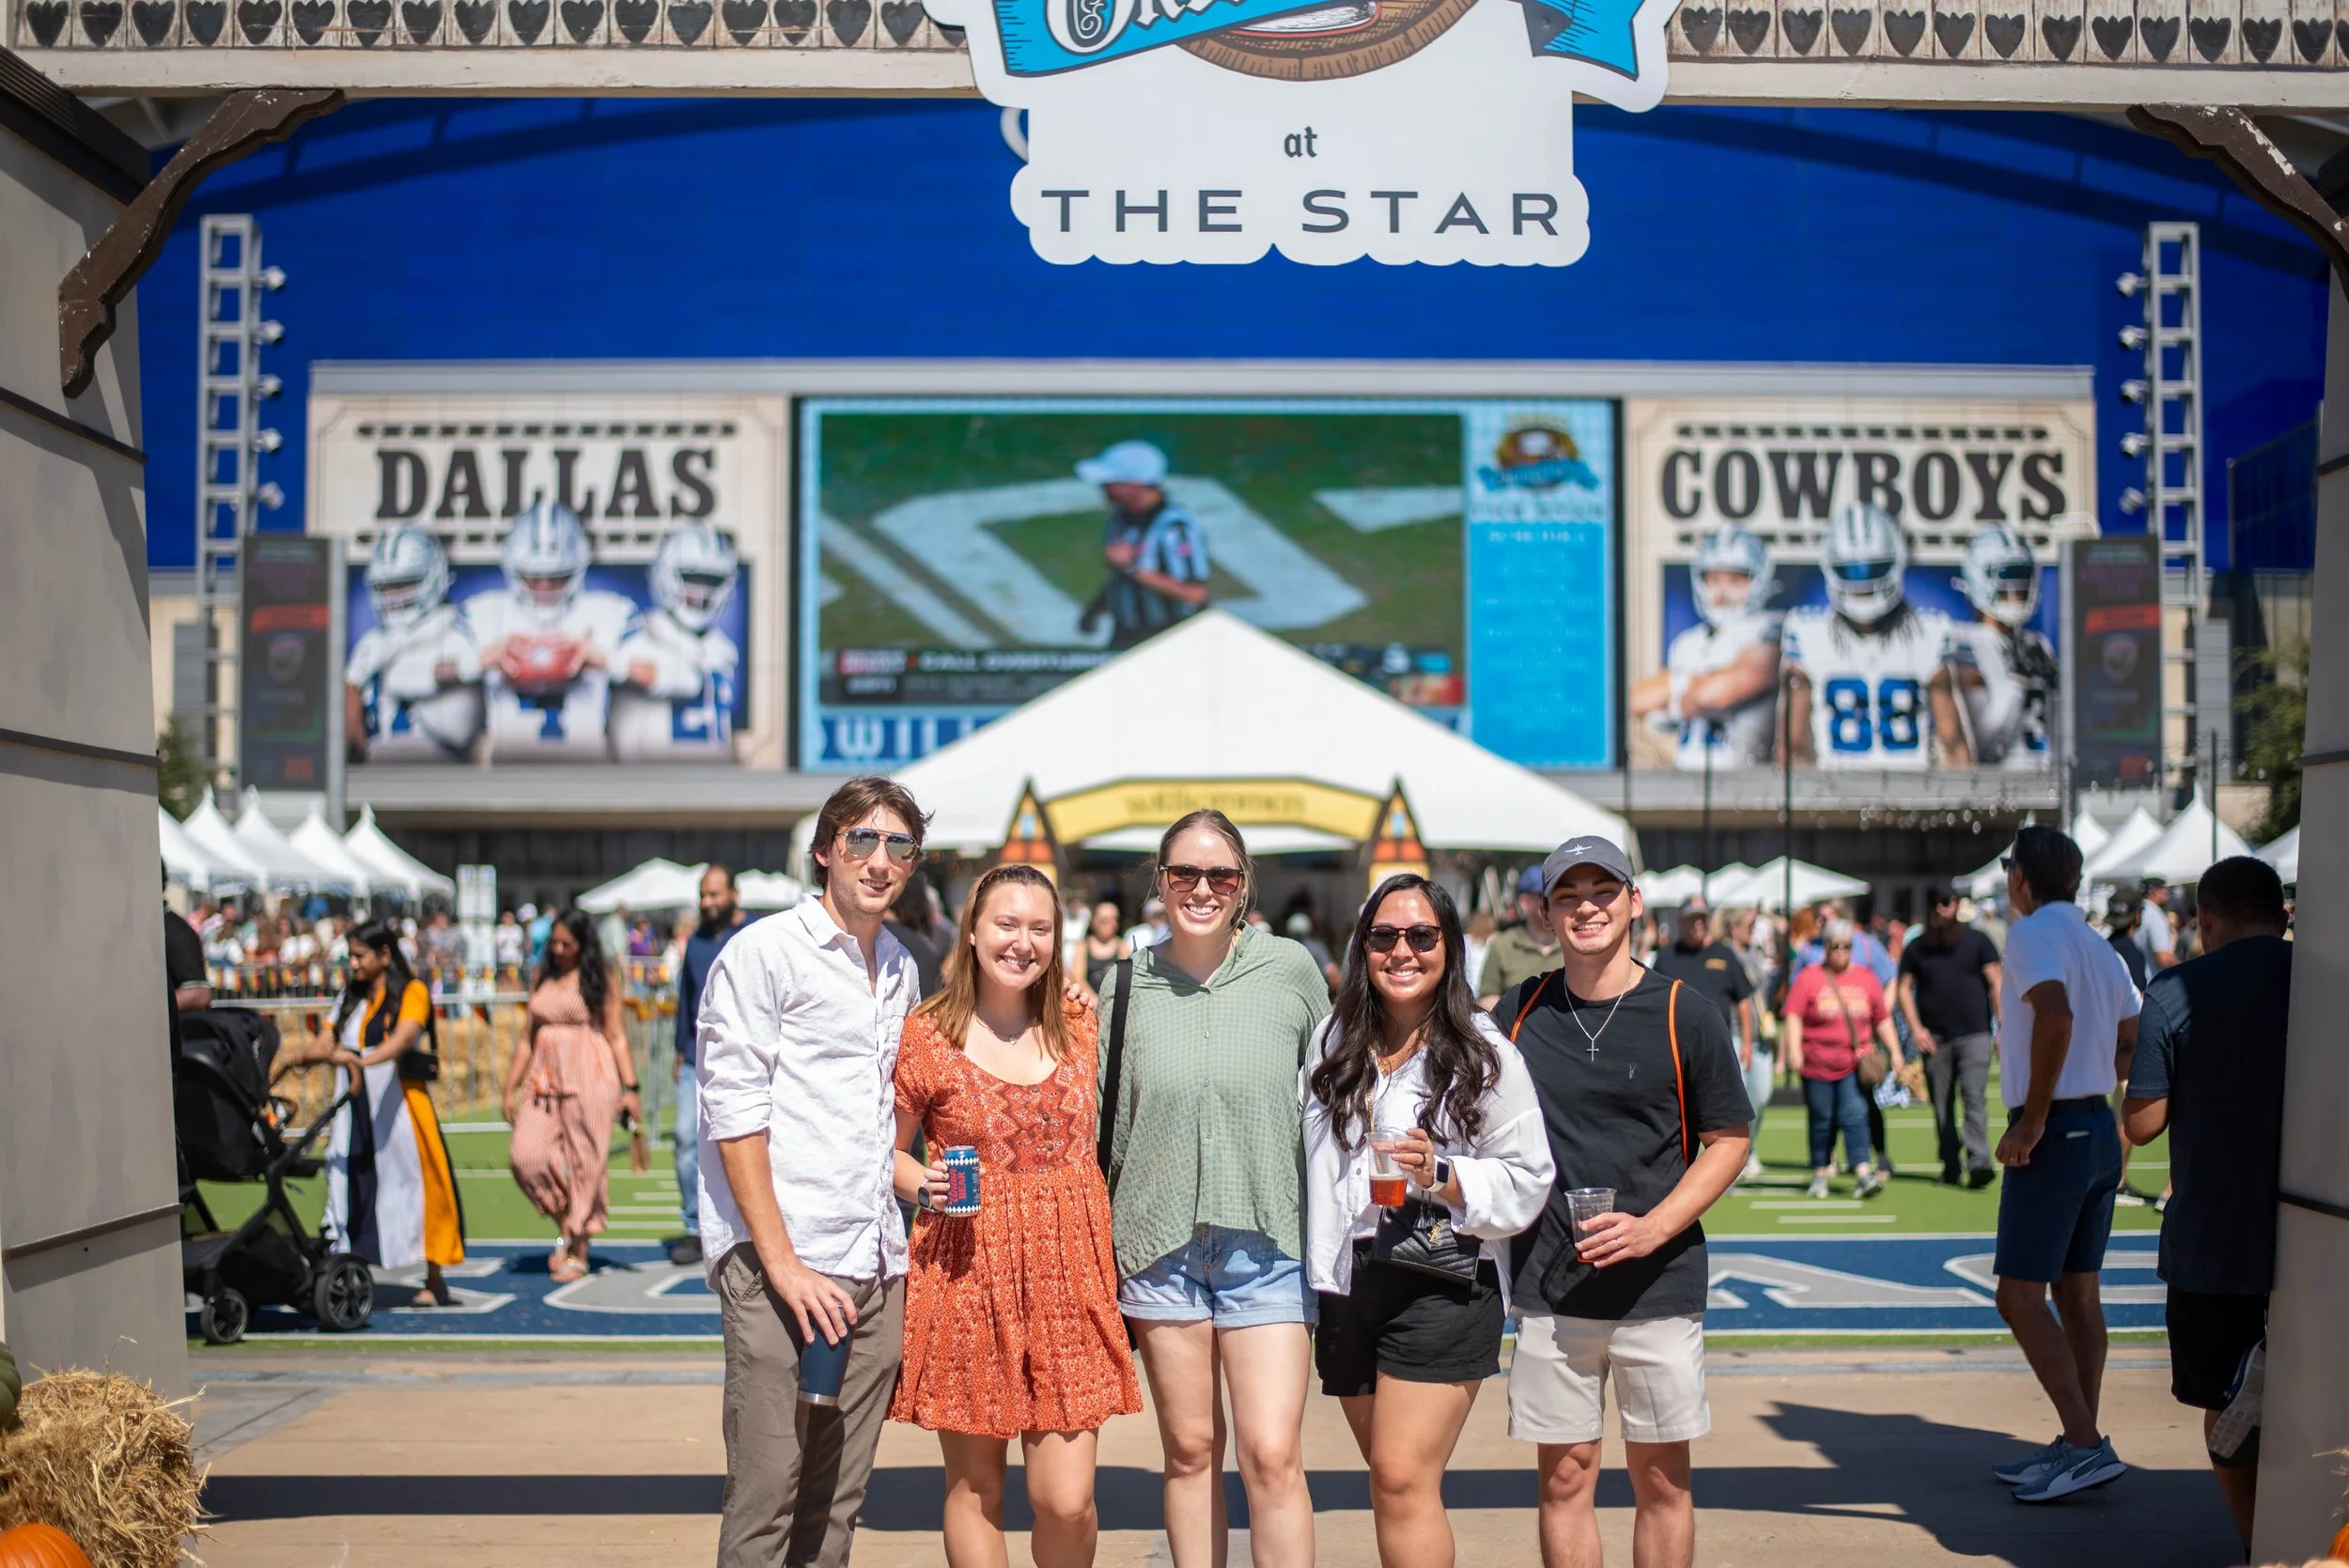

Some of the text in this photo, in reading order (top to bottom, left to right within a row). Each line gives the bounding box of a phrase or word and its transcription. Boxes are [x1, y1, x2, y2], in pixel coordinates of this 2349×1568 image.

[1283, 126, 1316, 158] at
[1041, 188, 1559, 237] THE STAR
[374, 446, 717, 520] DALLAS
[1660, 448, 2067, 521] COWBOYS
[1825, 677, 1921, 753] 88
[957, 1172, 967, 1200] BEAR
